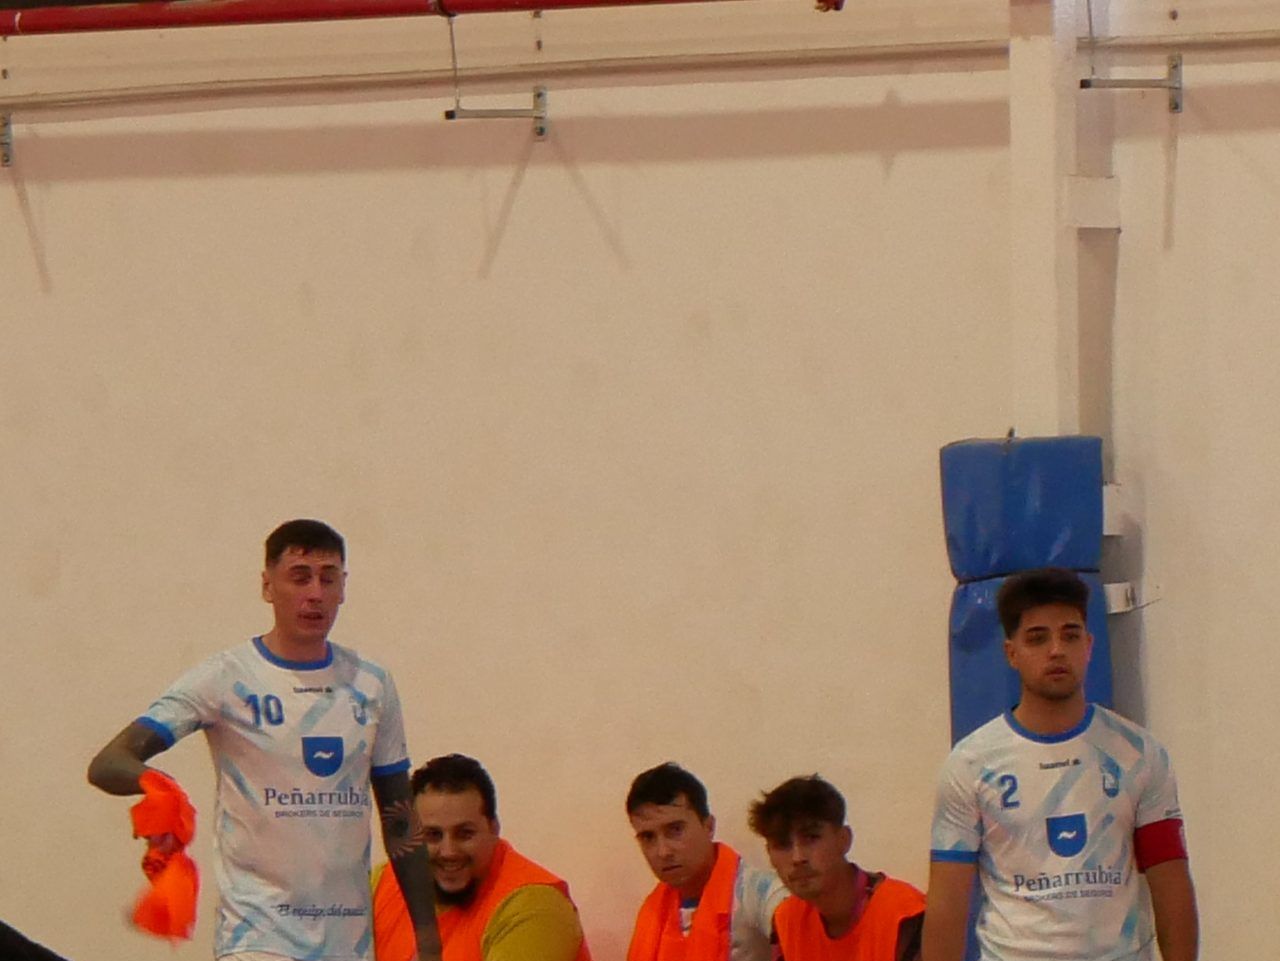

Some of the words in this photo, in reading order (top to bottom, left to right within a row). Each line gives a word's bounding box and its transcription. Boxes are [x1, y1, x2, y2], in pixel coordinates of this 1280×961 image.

[244, 694, 285, 727] 10
[1000, 774, 1020, 809] 2
[1013, 865, 1122, 892] Peñarrubia
